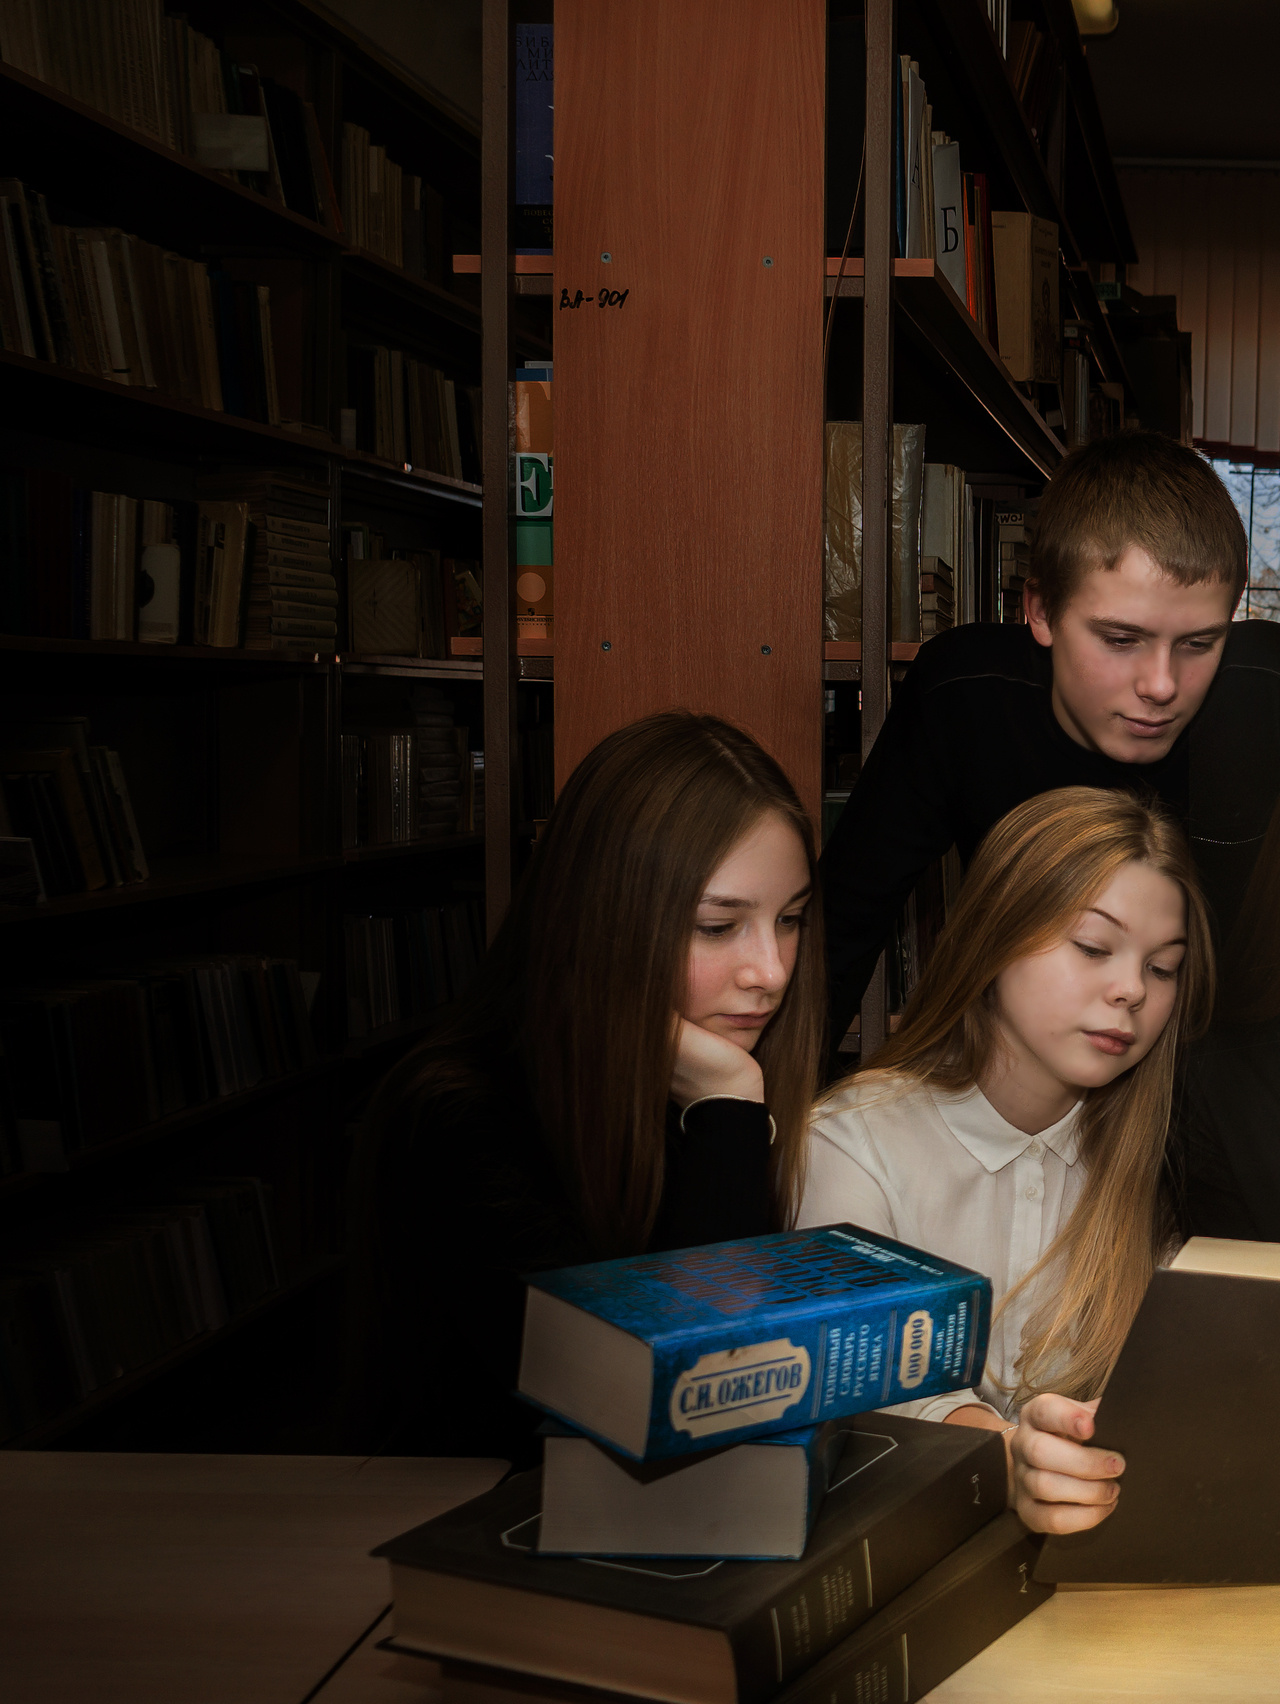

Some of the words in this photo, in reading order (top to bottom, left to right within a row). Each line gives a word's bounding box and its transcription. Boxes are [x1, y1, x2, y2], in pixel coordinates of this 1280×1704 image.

[516, 36, 554, 48] БИБ
[941, 206, 959, 254] Б
[868, 1333, 884, 1382] ЯЗЫКА
[910, 1318, 925, 1350] 000
[717, 1362, 803, 1405] ОЖЕГОВ
[823, 1327, 842, 1407] ТОЛКОВЫЙ
[839, 1331, 856, 1396] СЛОВАРЬ
[852, 1324, 871, 1397] РУССКОГО
[907, 1352, 923, 1380] 100
